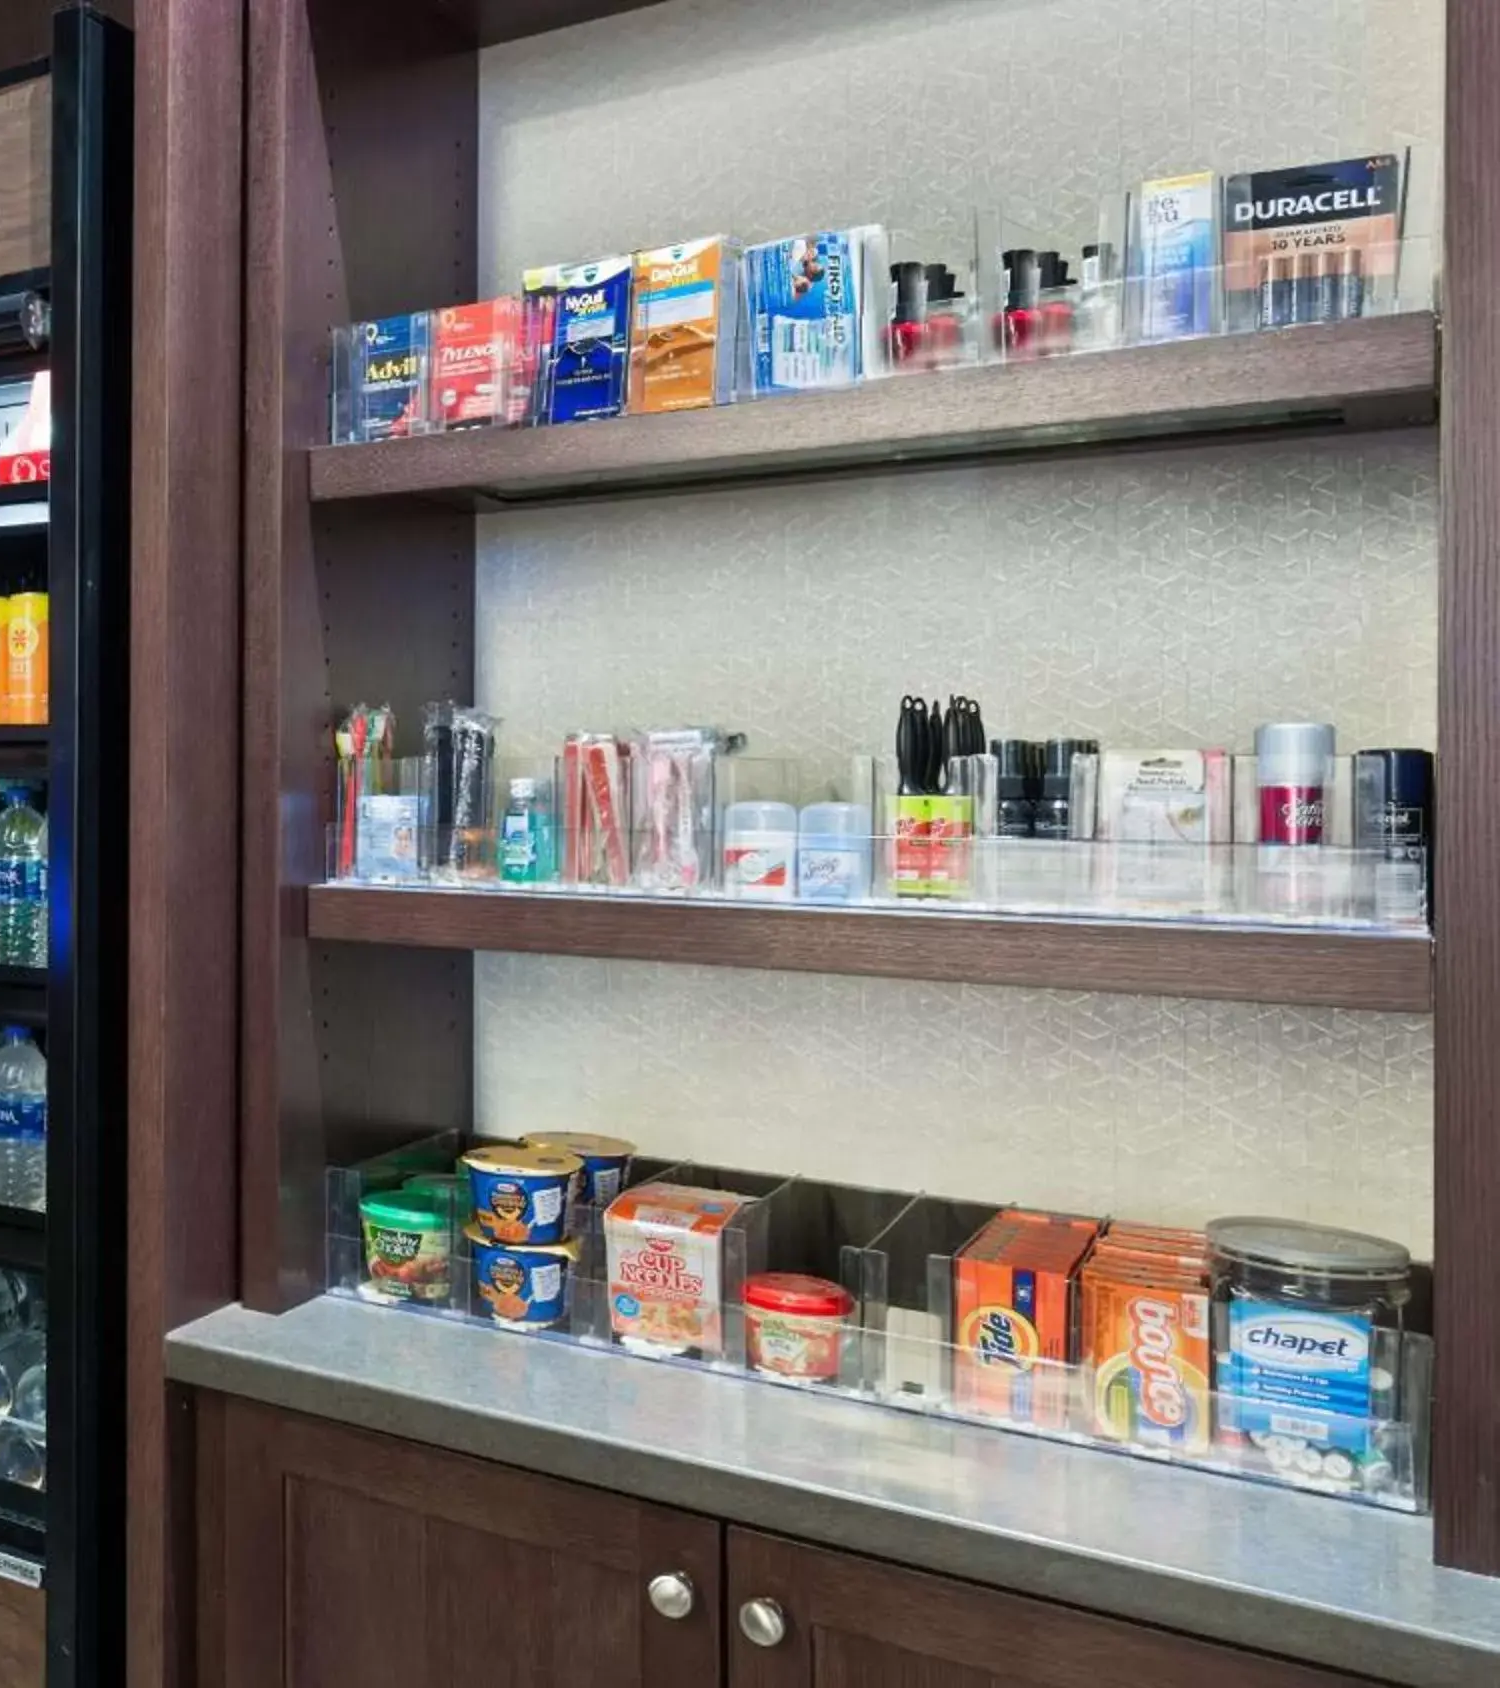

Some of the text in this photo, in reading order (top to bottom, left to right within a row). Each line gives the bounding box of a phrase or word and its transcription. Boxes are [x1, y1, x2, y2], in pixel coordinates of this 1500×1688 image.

[1235, 187, 1381, 222] DURACELL
[1293, 233, 1346, 248] YEARS
[367, 355, 417, 381] Advil
[979, 1311, 1022, 1369] Tide
